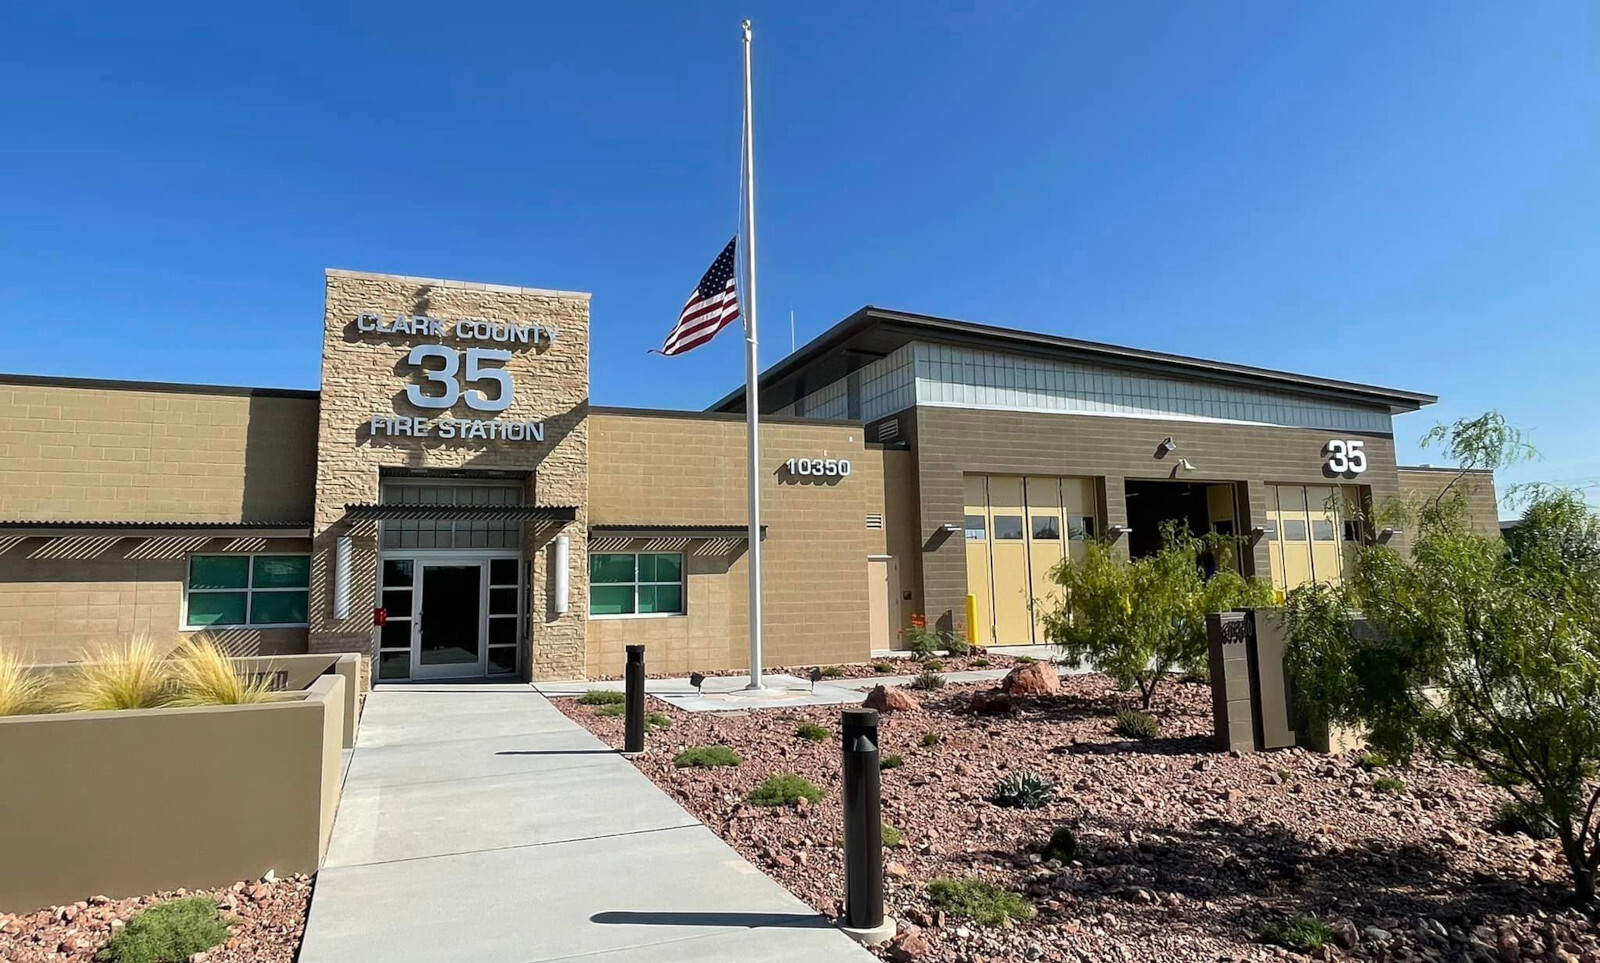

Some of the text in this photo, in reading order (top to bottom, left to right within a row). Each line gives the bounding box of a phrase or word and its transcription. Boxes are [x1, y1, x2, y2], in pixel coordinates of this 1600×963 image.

[357, 311, 560, 345] CLARK COUNTY
[406, 344, 513, 411] 35
[370, 415, 545, 442] FIRE STATION
[785, 457, 852, 477] 10350
[1328, 439, 1367, 473] 35
